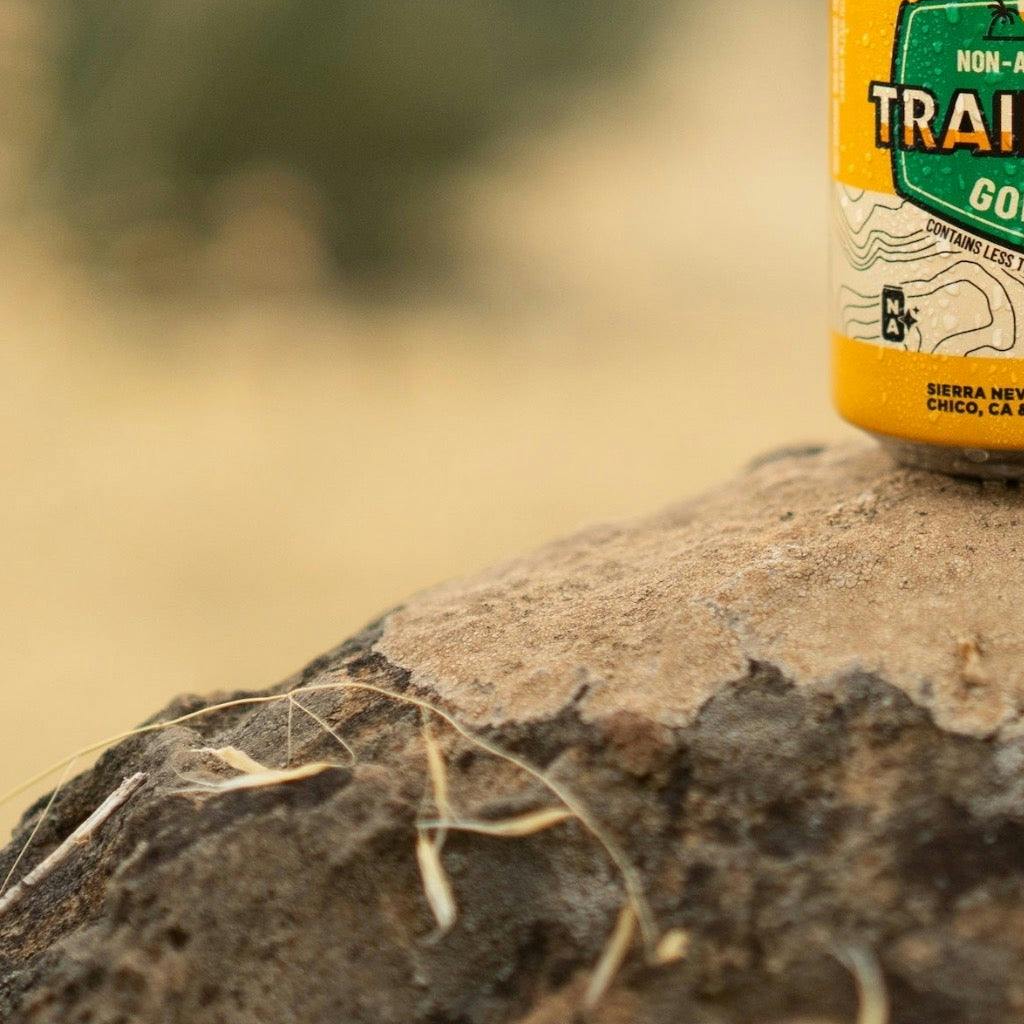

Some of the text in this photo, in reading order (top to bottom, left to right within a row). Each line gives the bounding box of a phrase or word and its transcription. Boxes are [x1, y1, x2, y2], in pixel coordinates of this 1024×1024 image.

[926, 218, 982, 256] CONTAINS
[983, 244, 1014, 268] LESS
[927, 382, 986, 400] SIERRA
[927, 397, 984, 417] CHICO,
[988, 402, 1012, 416] CA
